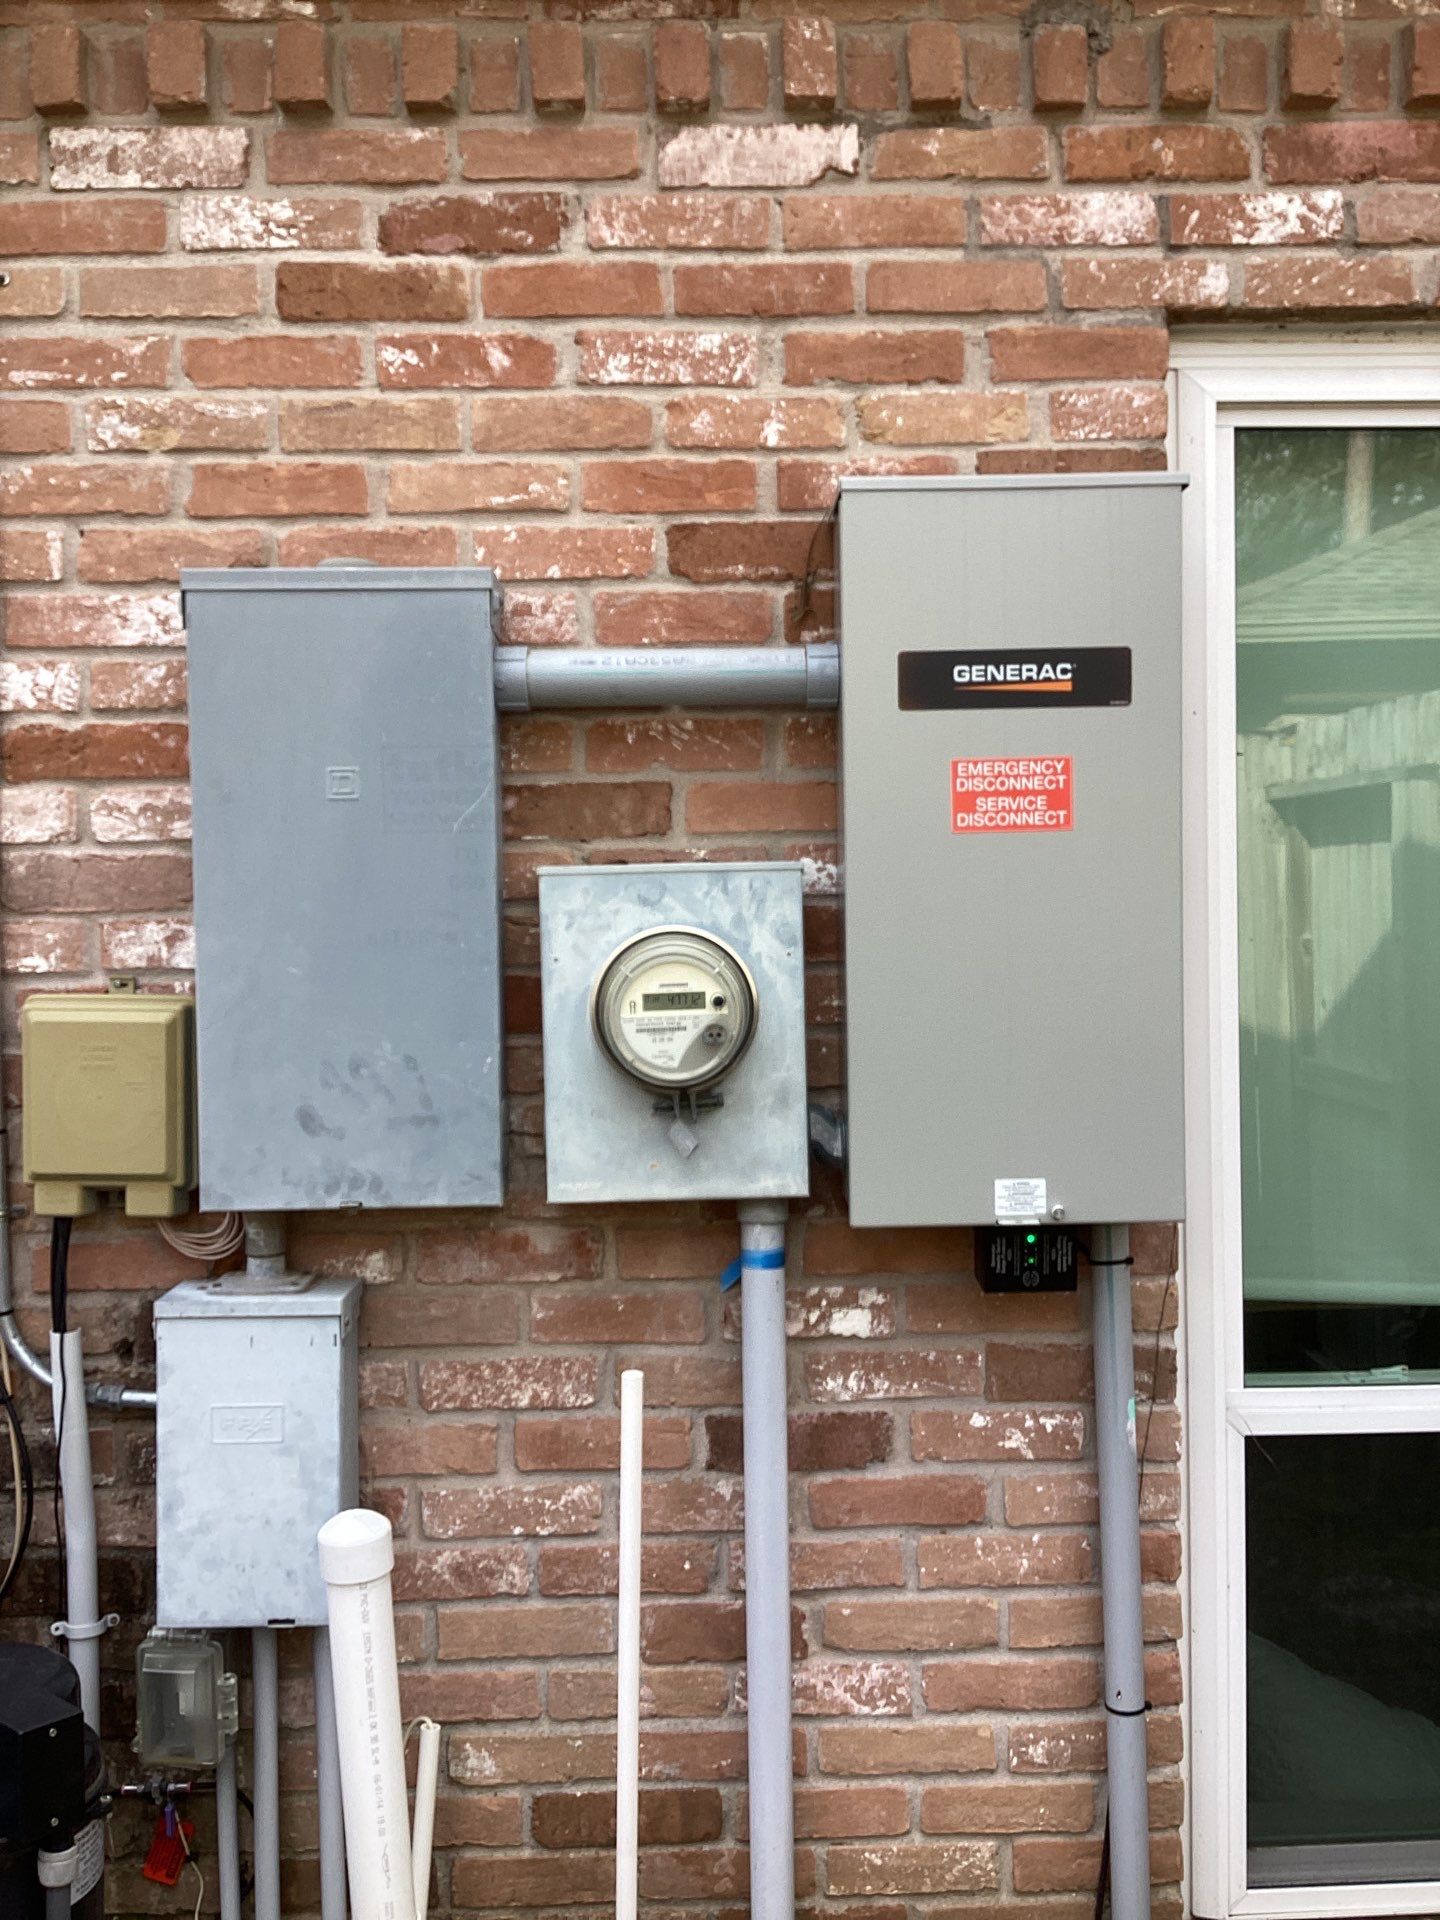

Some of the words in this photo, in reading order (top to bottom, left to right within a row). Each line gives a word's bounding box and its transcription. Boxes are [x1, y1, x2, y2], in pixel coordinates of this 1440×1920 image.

[953, 662, 1073, 683] GENERAC
[957, 759, 1065, 776] EMERGENCY
[956, 775, 1067, 792] DISCONNECT
[975, 795, 1048, 811] SERVICE
[956, 810, 1068, 828] DISCONNECT
